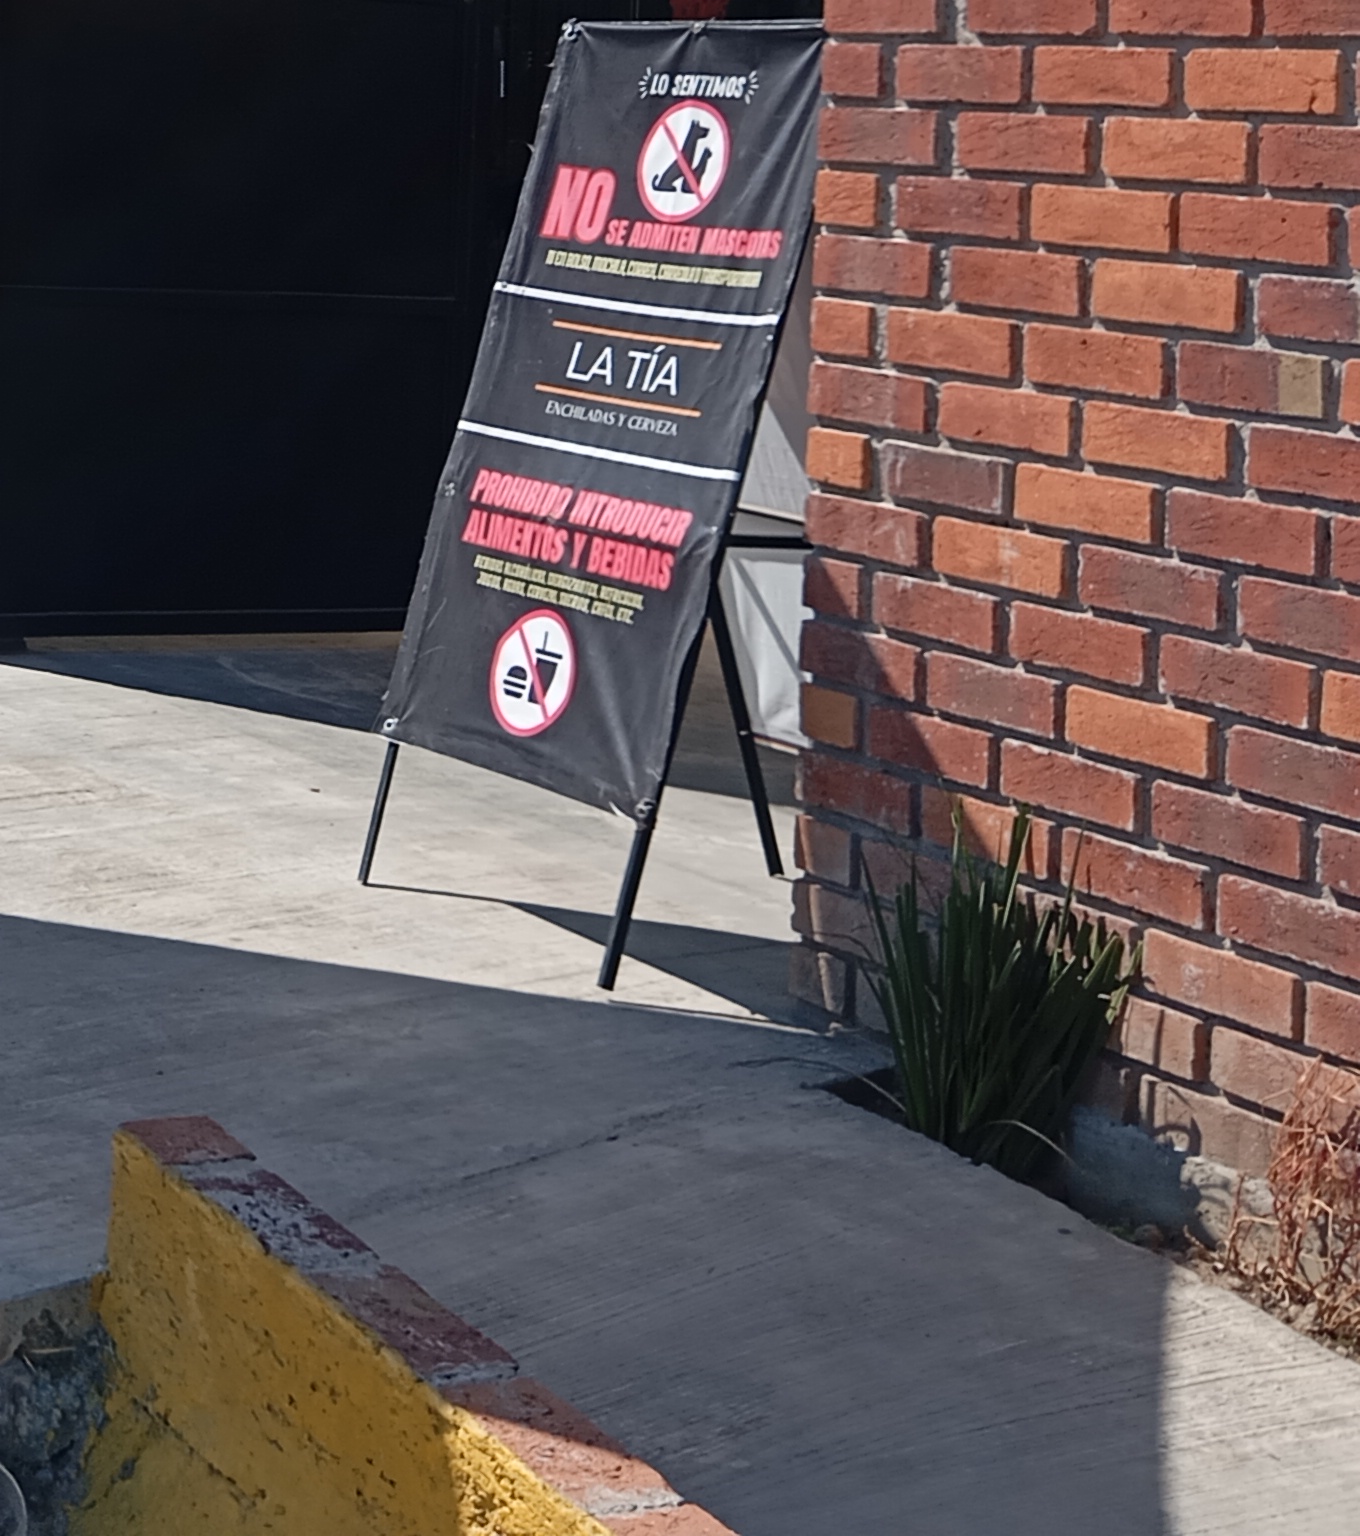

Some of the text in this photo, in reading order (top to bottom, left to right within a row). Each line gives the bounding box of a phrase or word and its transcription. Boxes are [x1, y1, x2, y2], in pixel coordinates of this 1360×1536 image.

[650, 73, 747, 98] LO SENTIMOS
[539, 163, 616, 244] NO
[605, 219, 629, 246] SE
[627, 221, 701, 254] ADMITEN
[566, 341, 678, 396] LA TÍA
[545, 400, 678, 436] ENCHILADAS Y CERVEZA
[469, 468, 694, 547] PROHIBIDO INTRODUCIR
[461, 508, 569, 564] ALIMENTOS
[569, 531, 588, 569] Y
[586, 536, 676, 591] BEBIDAS
